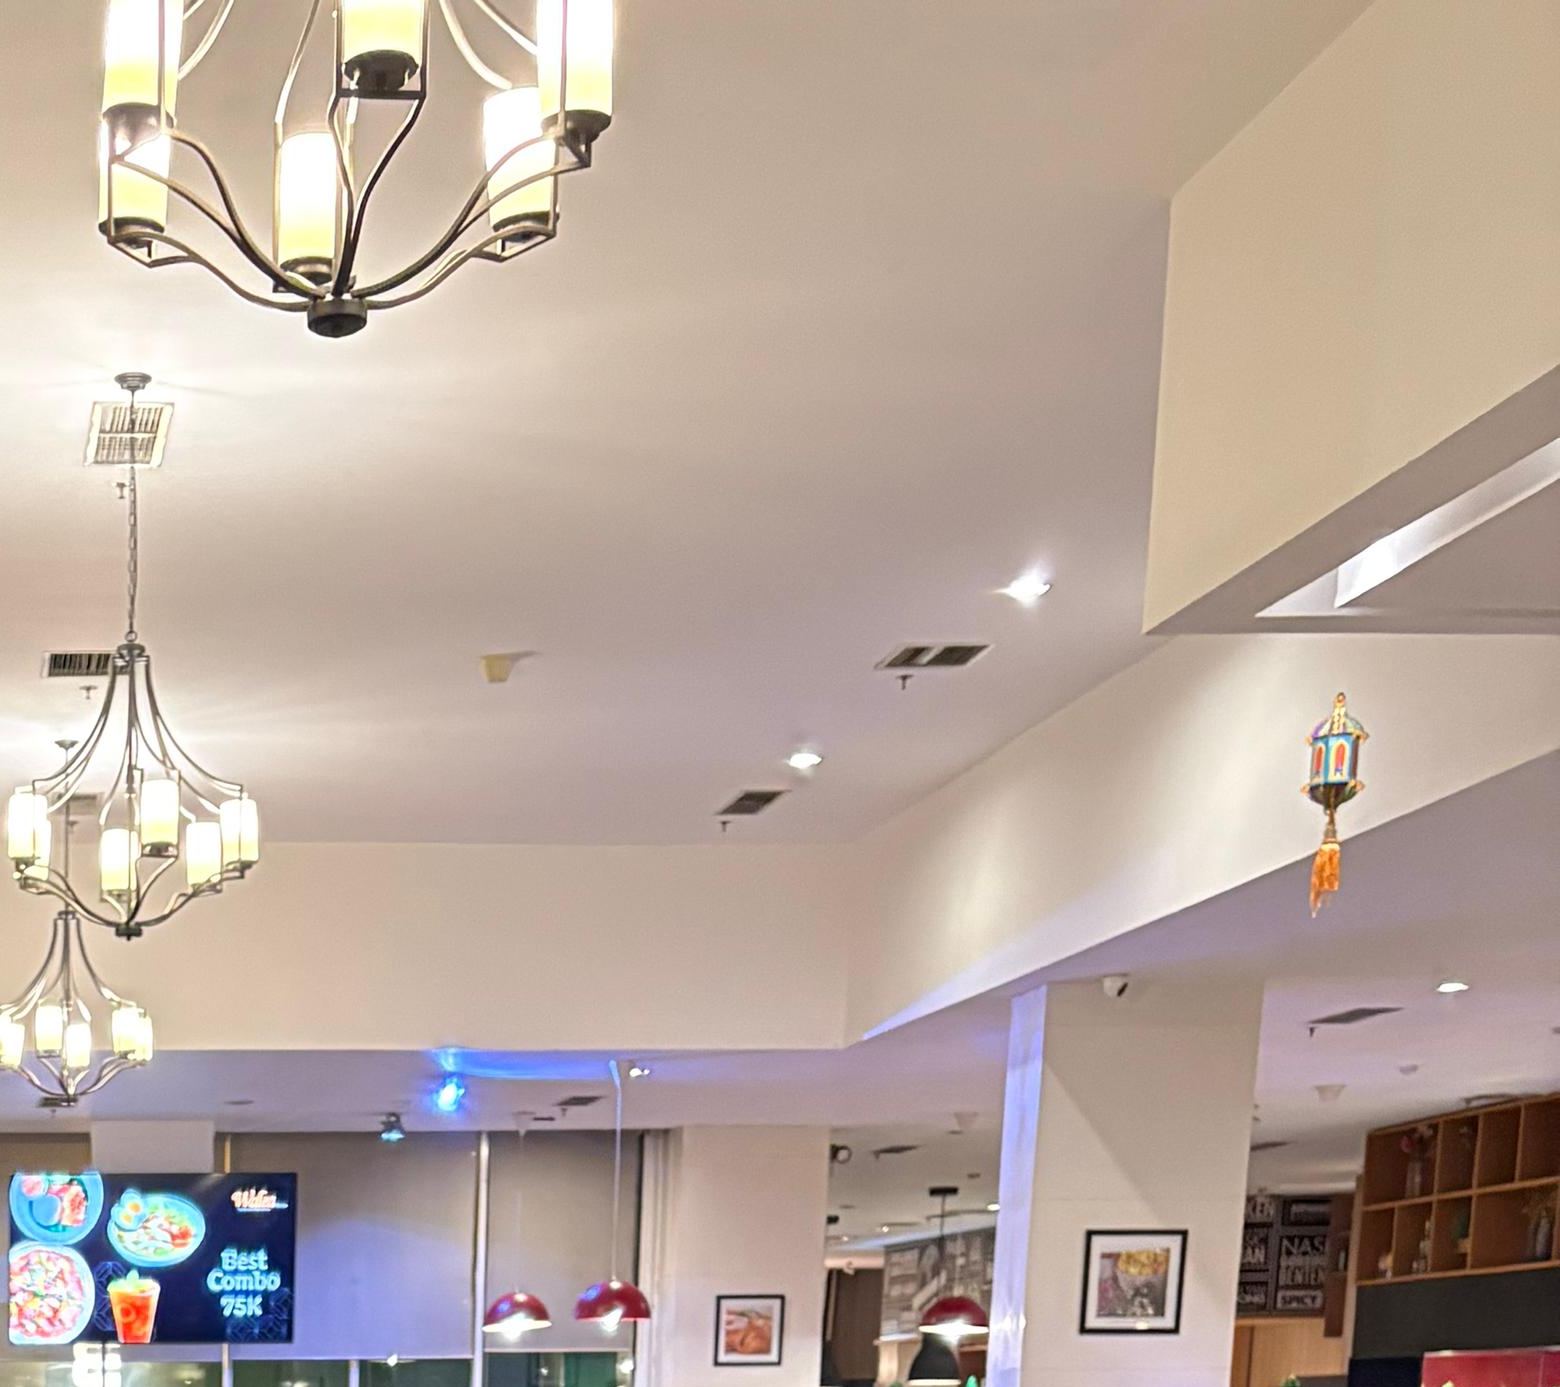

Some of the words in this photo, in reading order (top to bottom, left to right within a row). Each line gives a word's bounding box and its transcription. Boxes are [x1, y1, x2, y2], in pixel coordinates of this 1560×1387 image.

[220, 1248, 268, 1271] Best
[206, 1268, 281, 1293] Combo
[220, 1294, 263, 1317] 75K
